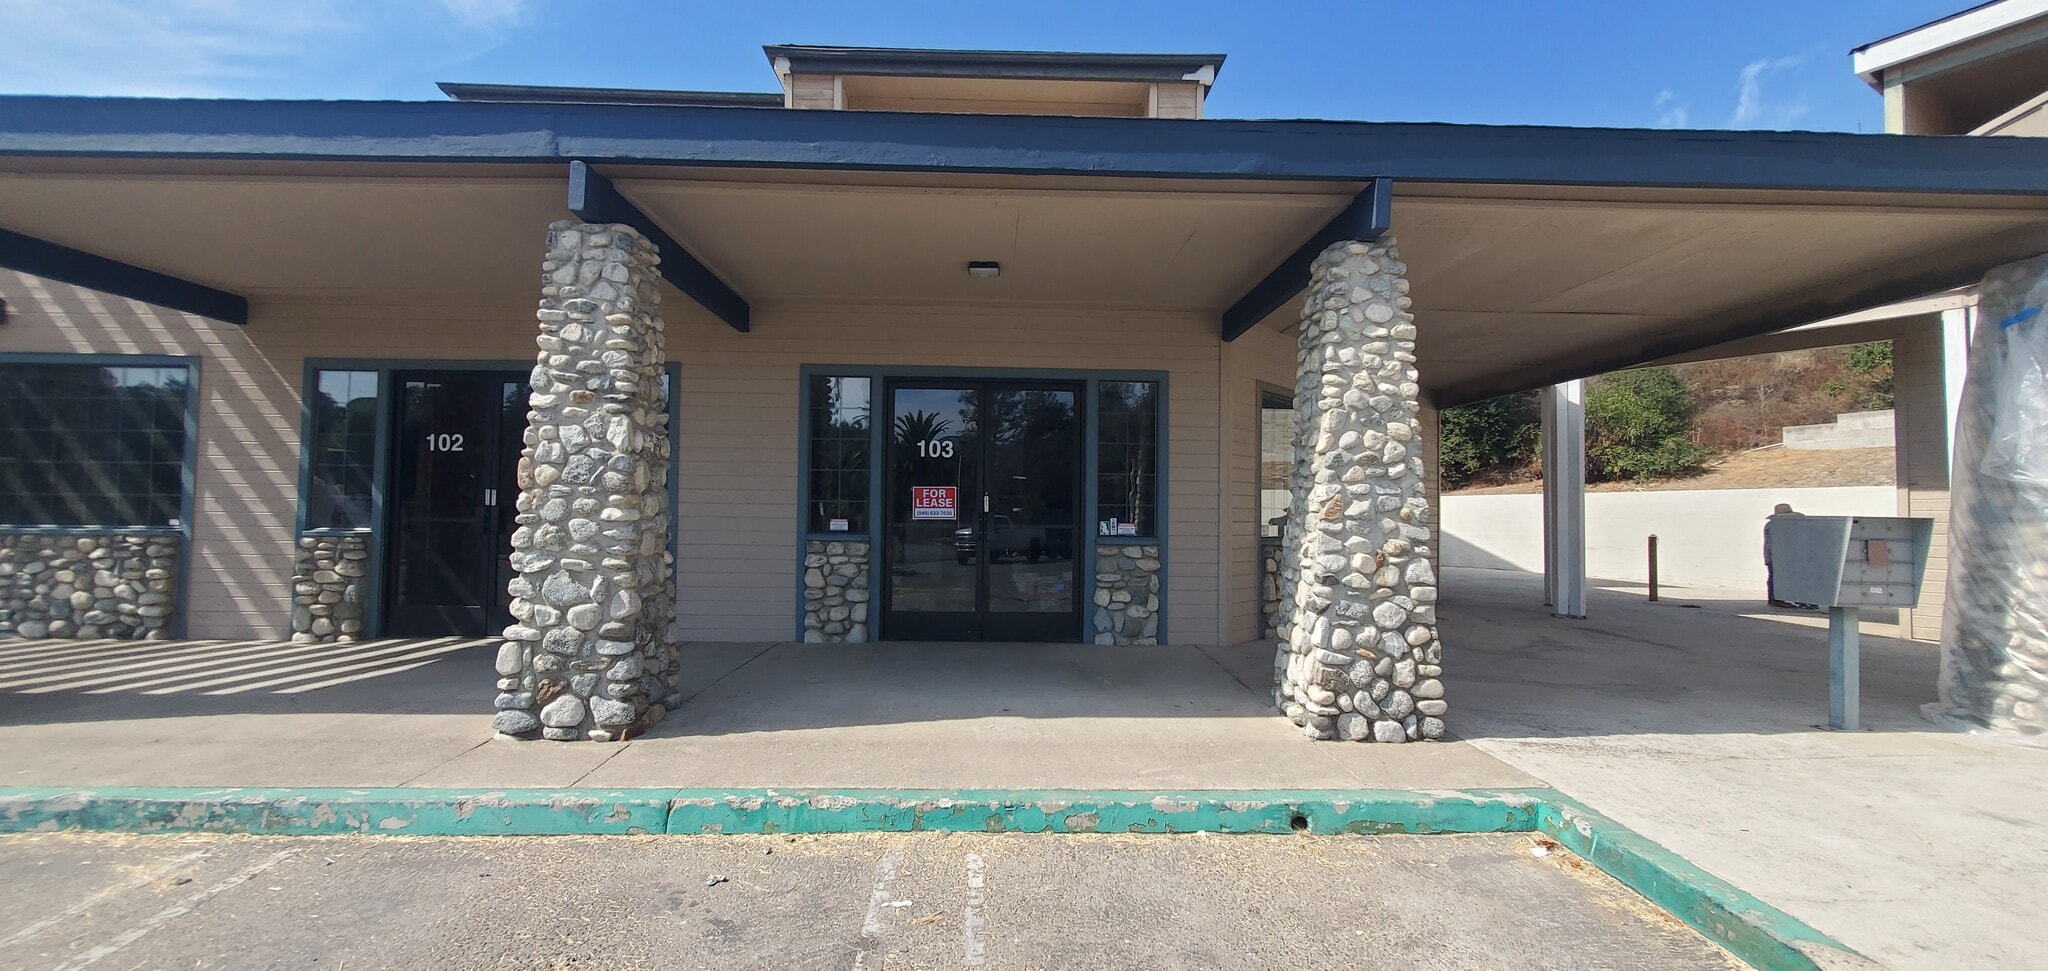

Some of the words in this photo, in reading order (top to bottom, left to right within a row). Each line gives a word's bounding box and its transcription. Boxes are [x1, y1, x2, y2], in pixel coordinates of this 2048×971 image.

[426, 433, 464, 451] 102
[917, 440, 954, 458] 103
[922, 489, 946, 498] FOR
[916, 498, 953, 507] LEASE
